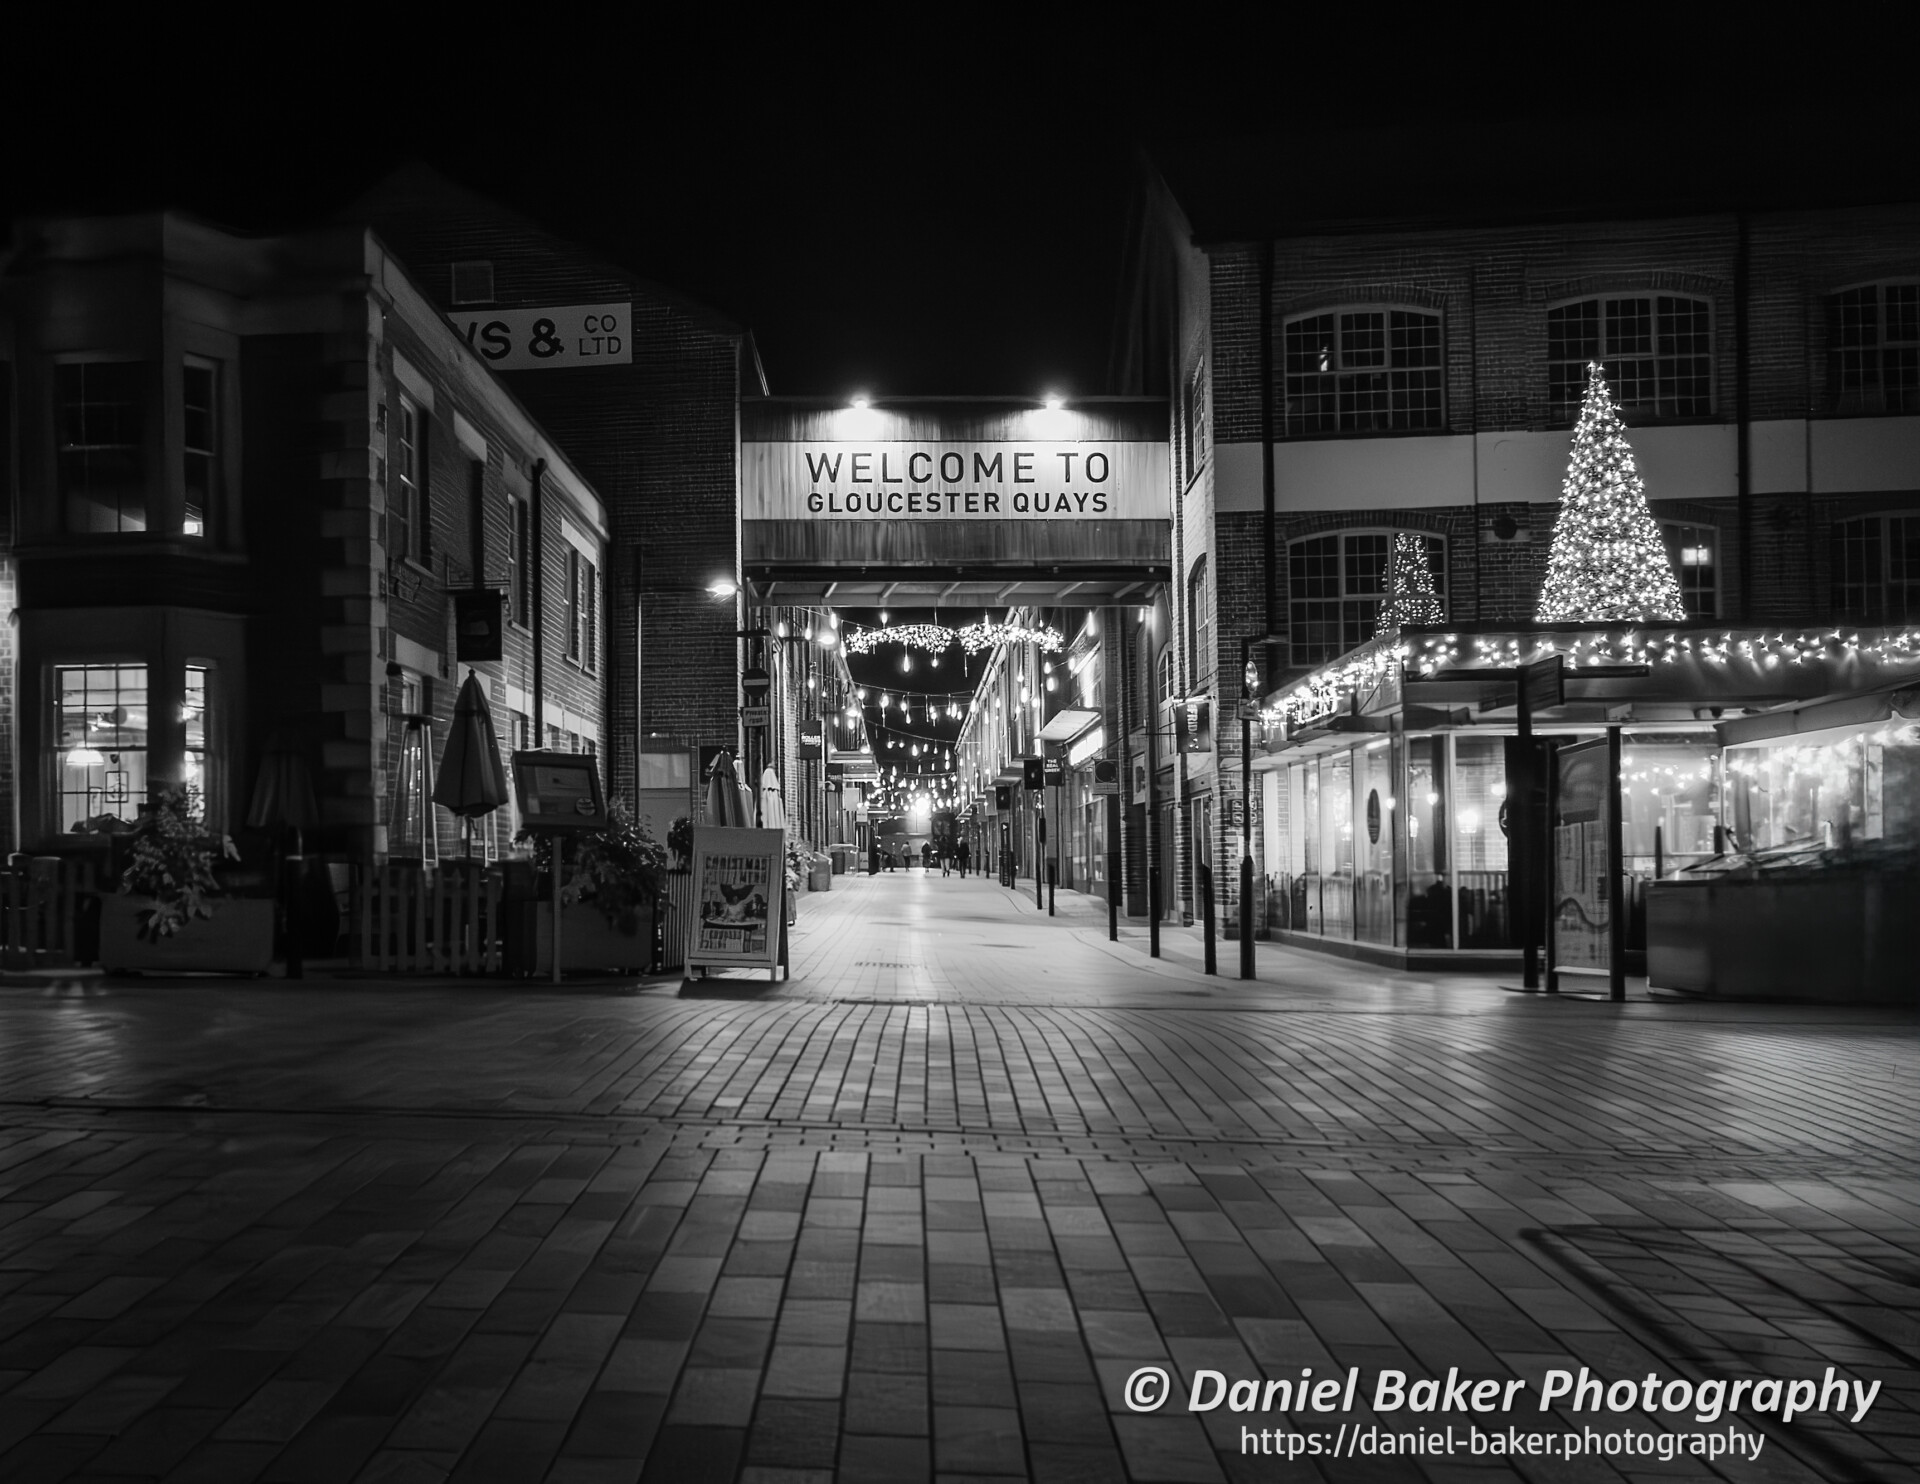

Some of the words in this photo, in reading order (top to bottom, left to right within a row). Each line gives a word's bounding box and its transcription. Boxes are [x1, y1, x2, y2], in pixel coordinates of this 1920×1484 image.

[584, 315, 616, 333] CO
[528, 318, 564, 358] &
[579, 336, 622, 356] LTD
[805, 452, 1035, 483] WELCOME
[1056, 452, 1109, 483] TO
[807, 492, 1000, 513] GLOUCESTER
[1013, 492, 1108, 513] QUAYS
